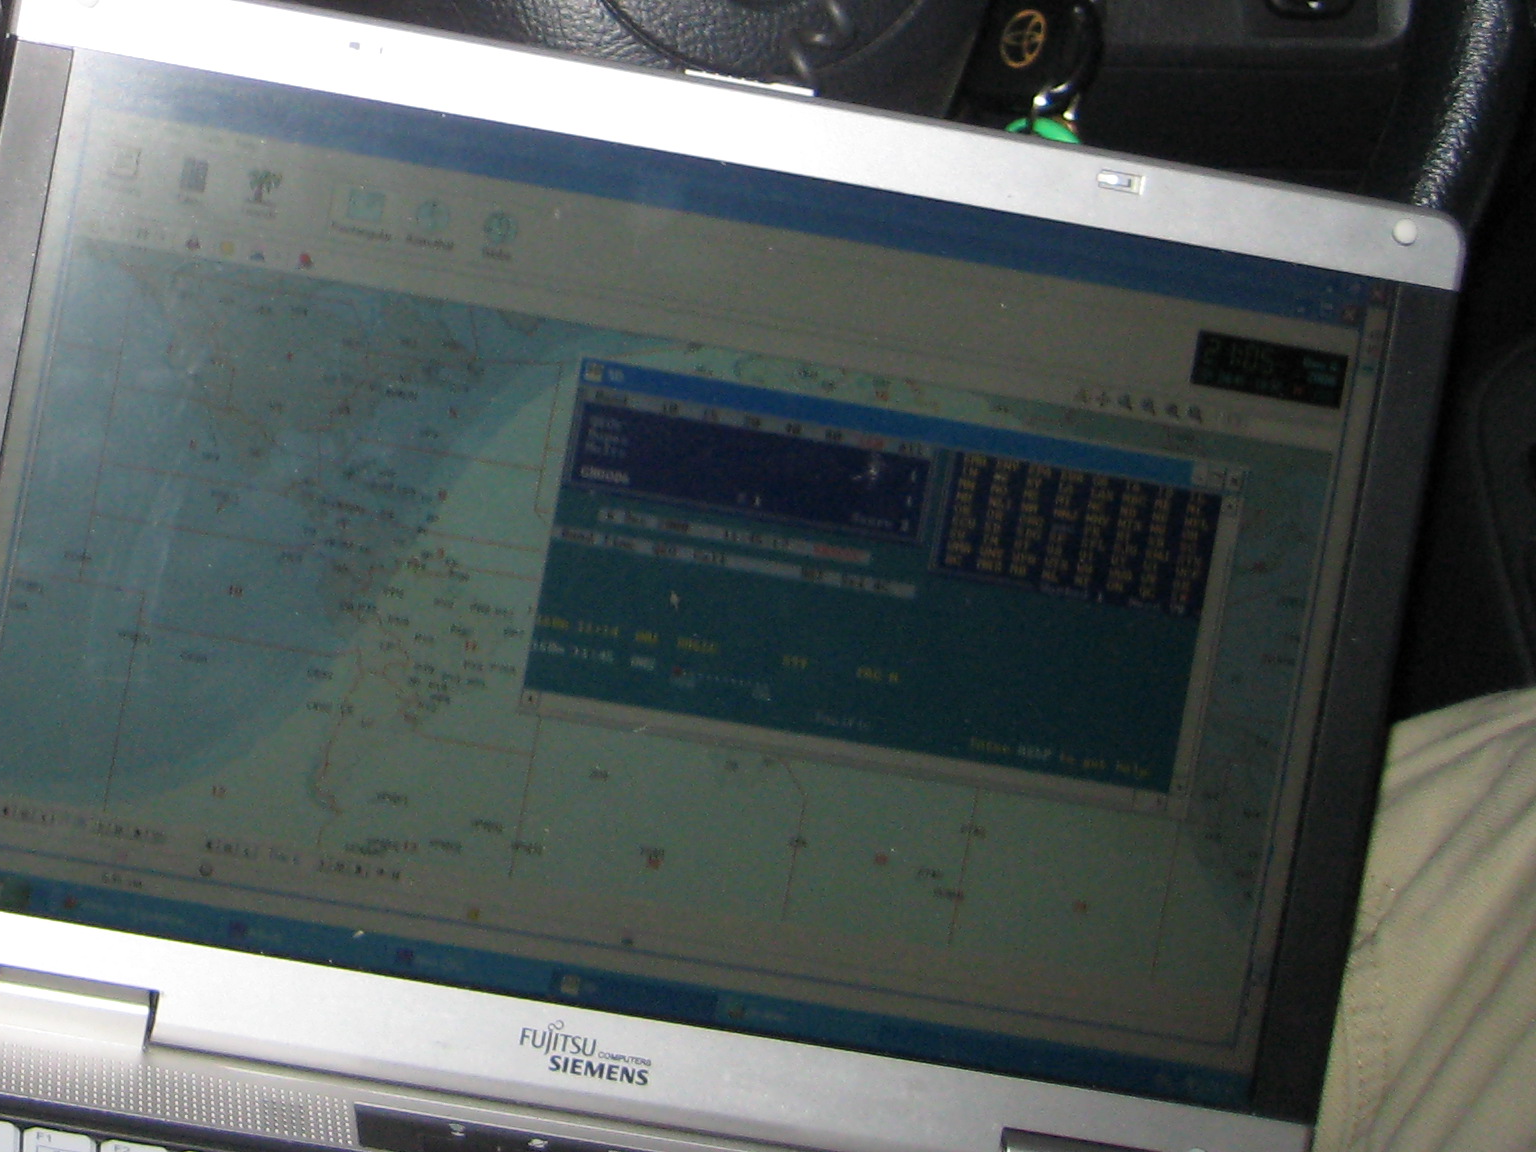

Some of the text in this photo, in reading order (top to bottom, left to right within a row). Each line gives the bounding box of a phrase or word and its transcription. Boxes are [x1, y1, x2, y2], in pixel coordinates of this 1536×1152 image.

[519, 1019, 597, 1057] FUJITSU
[548, 1055, 649, 1086] SIEMENS
[598, 1051, 651, 1067] COMPUTERS
[35, 1131, 52, 1143] F1
